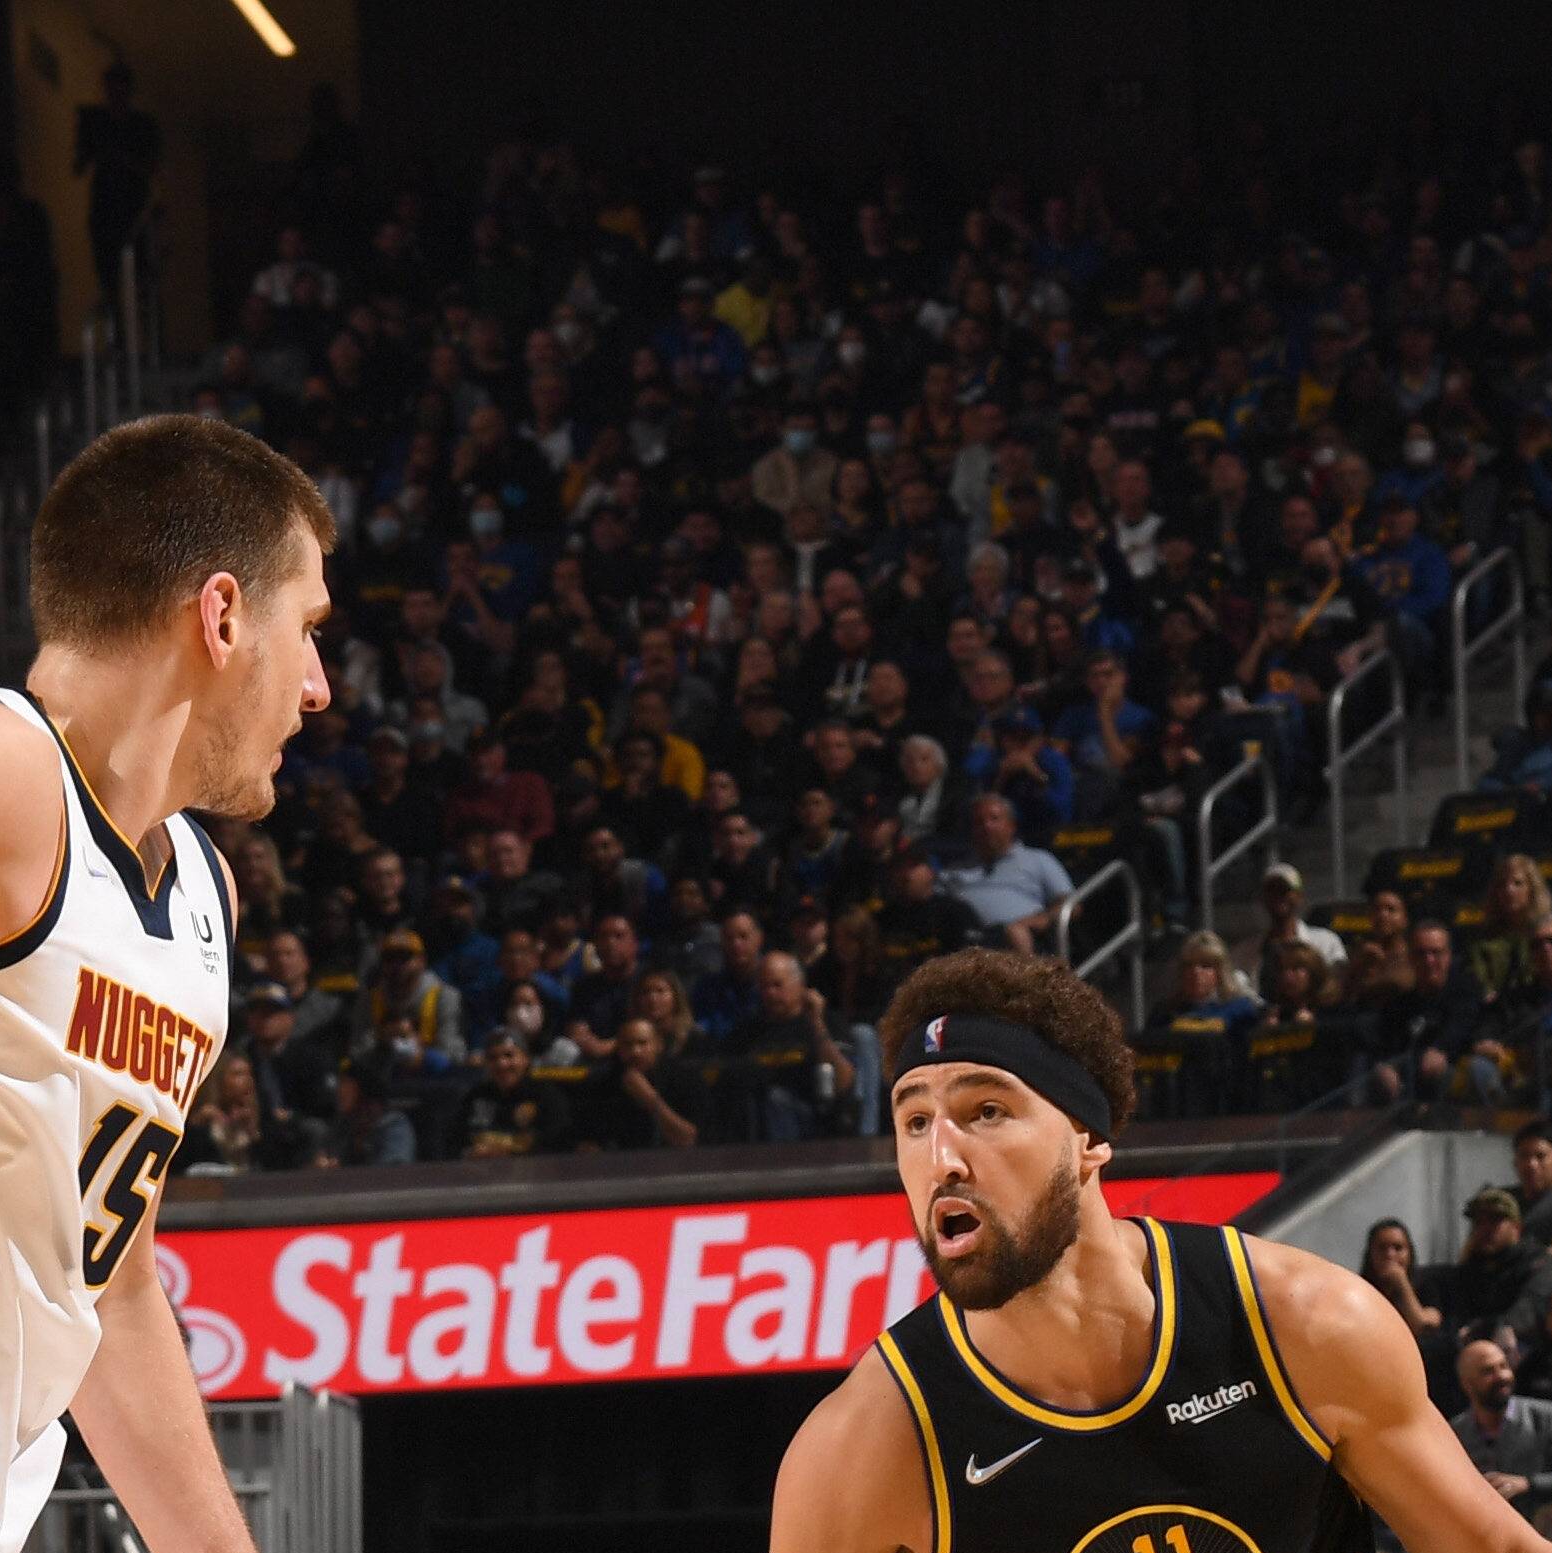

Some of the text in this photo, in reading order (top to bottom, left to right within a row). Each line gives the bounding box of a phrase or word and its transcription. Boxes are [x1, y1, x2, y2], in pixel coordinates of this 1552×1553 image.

[77, 1098, 183, 1290] 15
[264, 1226, 642, 1385] State
[1166, 1379, 1258, 1425] Rakuten
